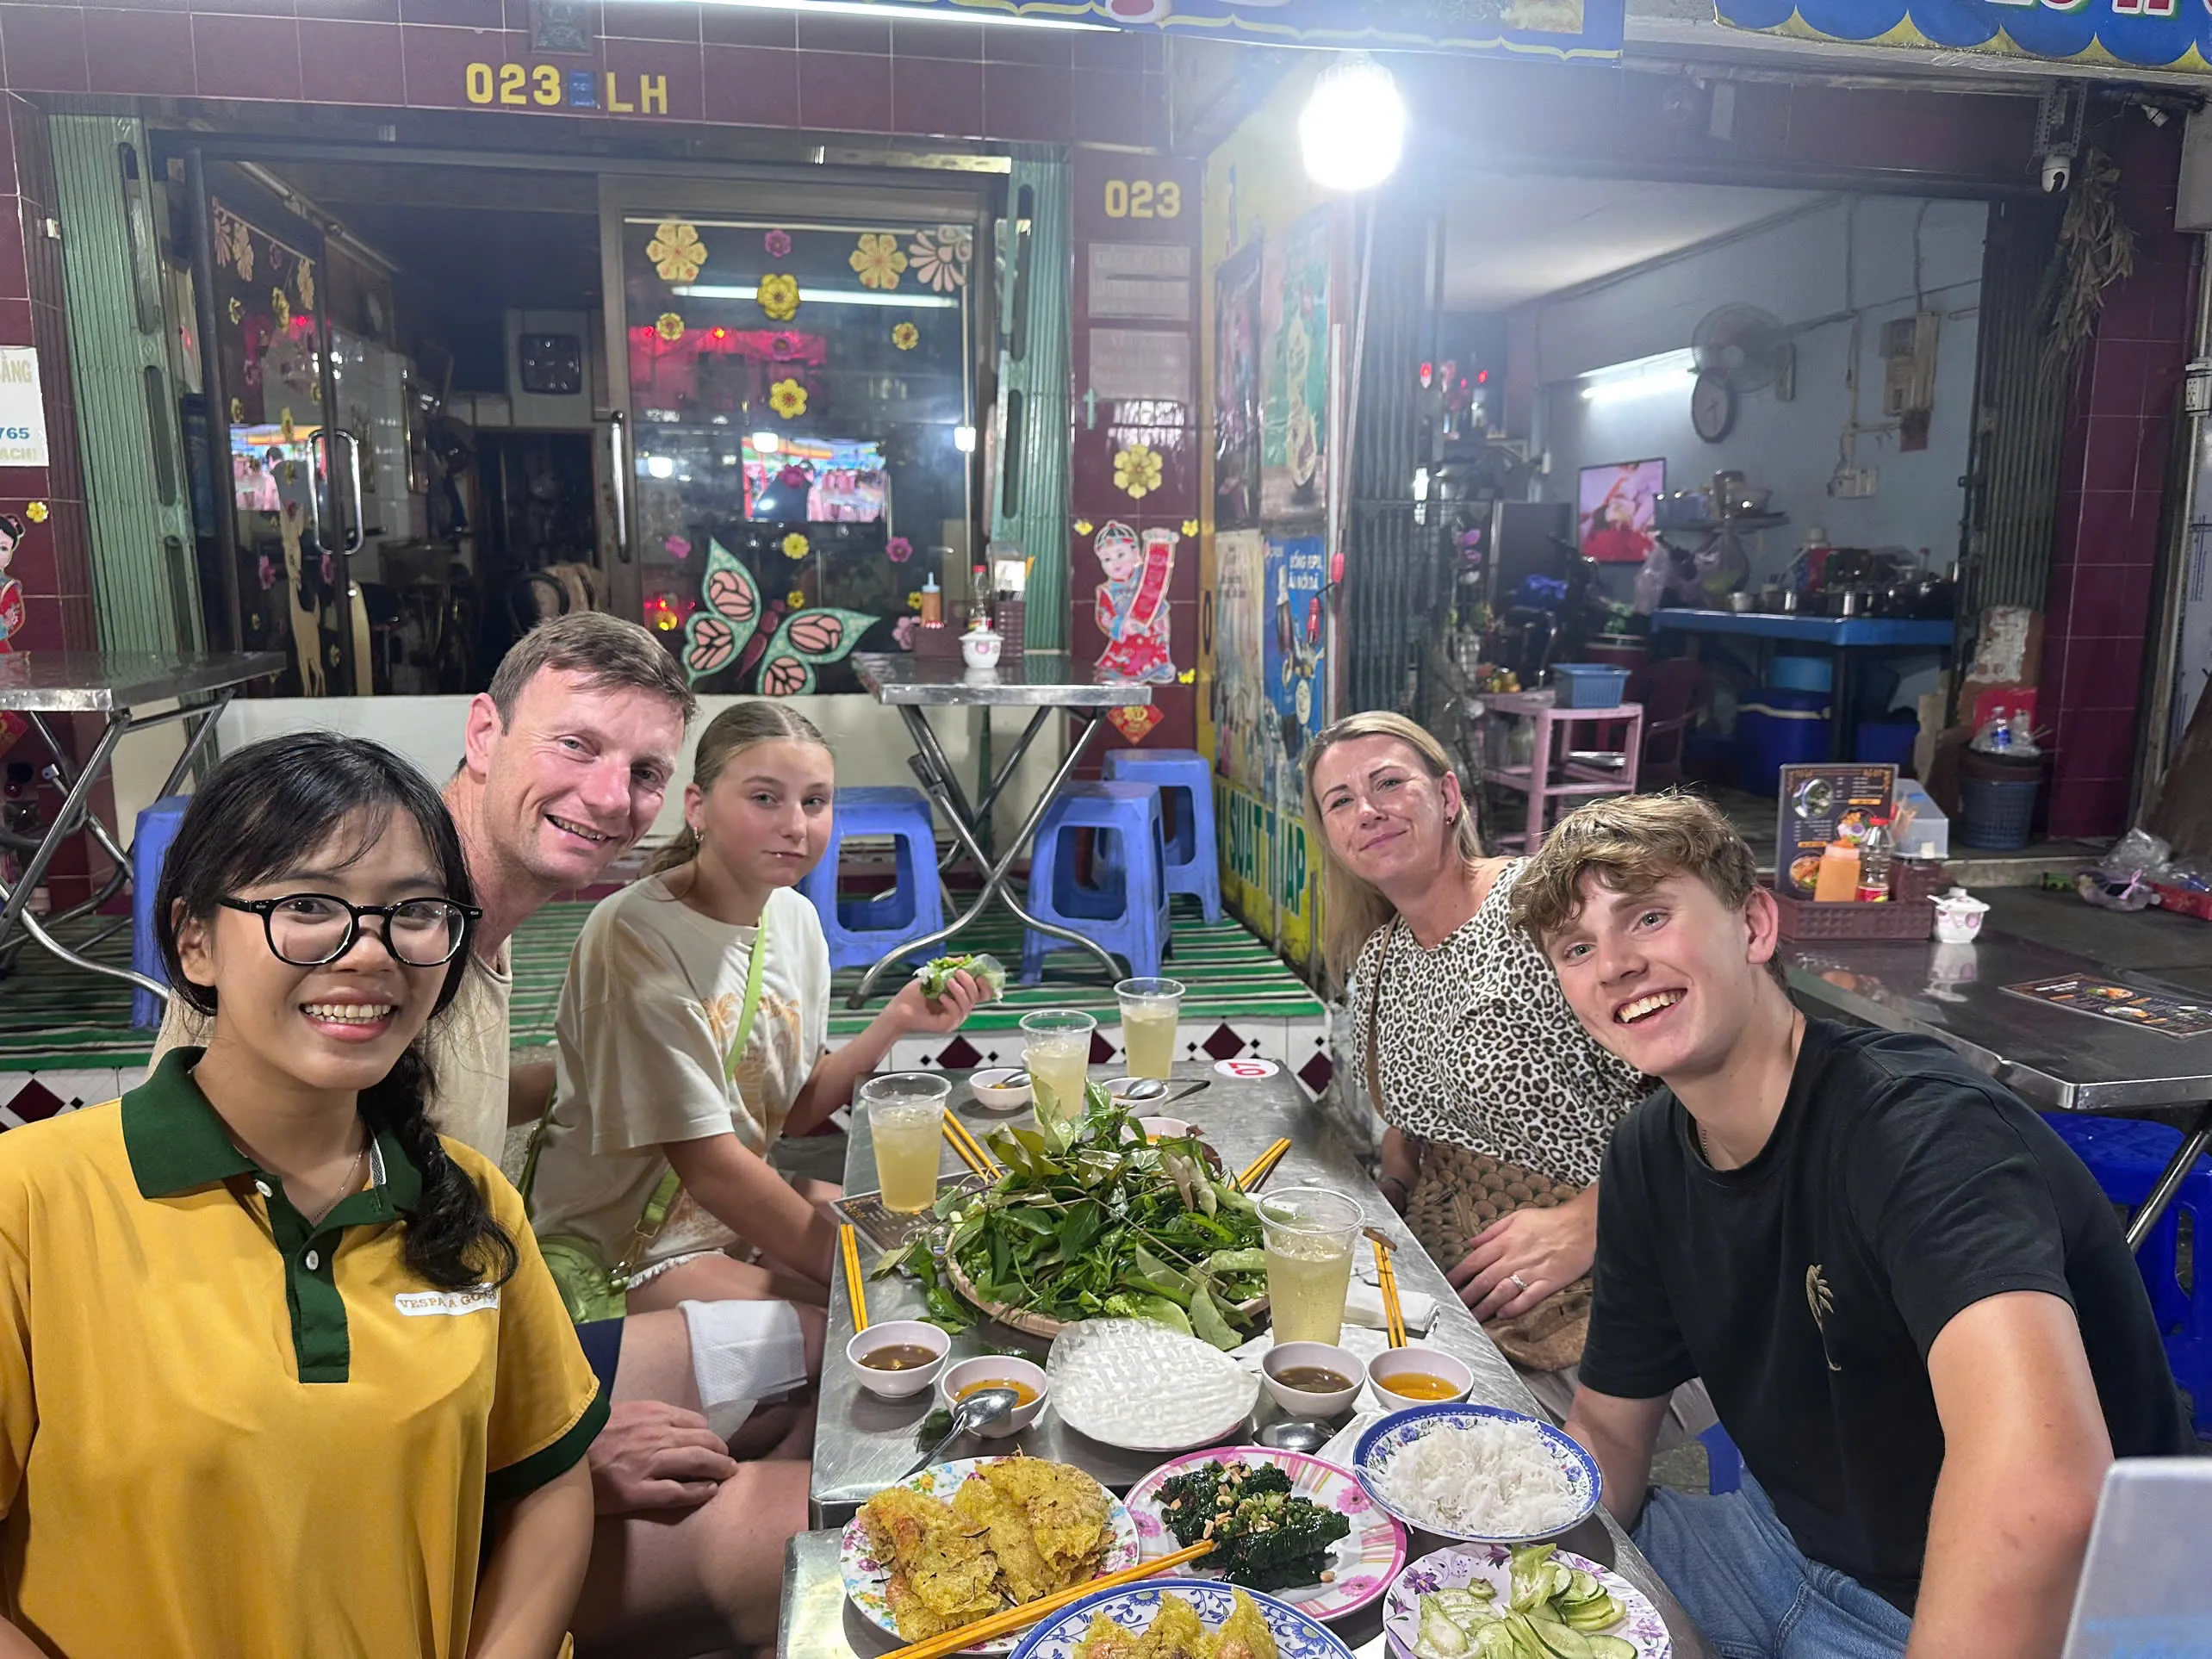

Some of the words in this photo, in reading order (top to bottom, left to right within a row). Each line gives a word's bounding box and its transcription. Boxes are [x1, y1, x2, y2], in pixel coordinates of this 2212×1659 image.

[466, 62, 561, 105] 023
[606, 71, 668, 115] LH
[1105, 180, 1181, 218] 023
[399, 1296, 446, 1308] VESPA
[448, 1299, 457, 1308] A
[460, 1292, 481, 1305] GO
